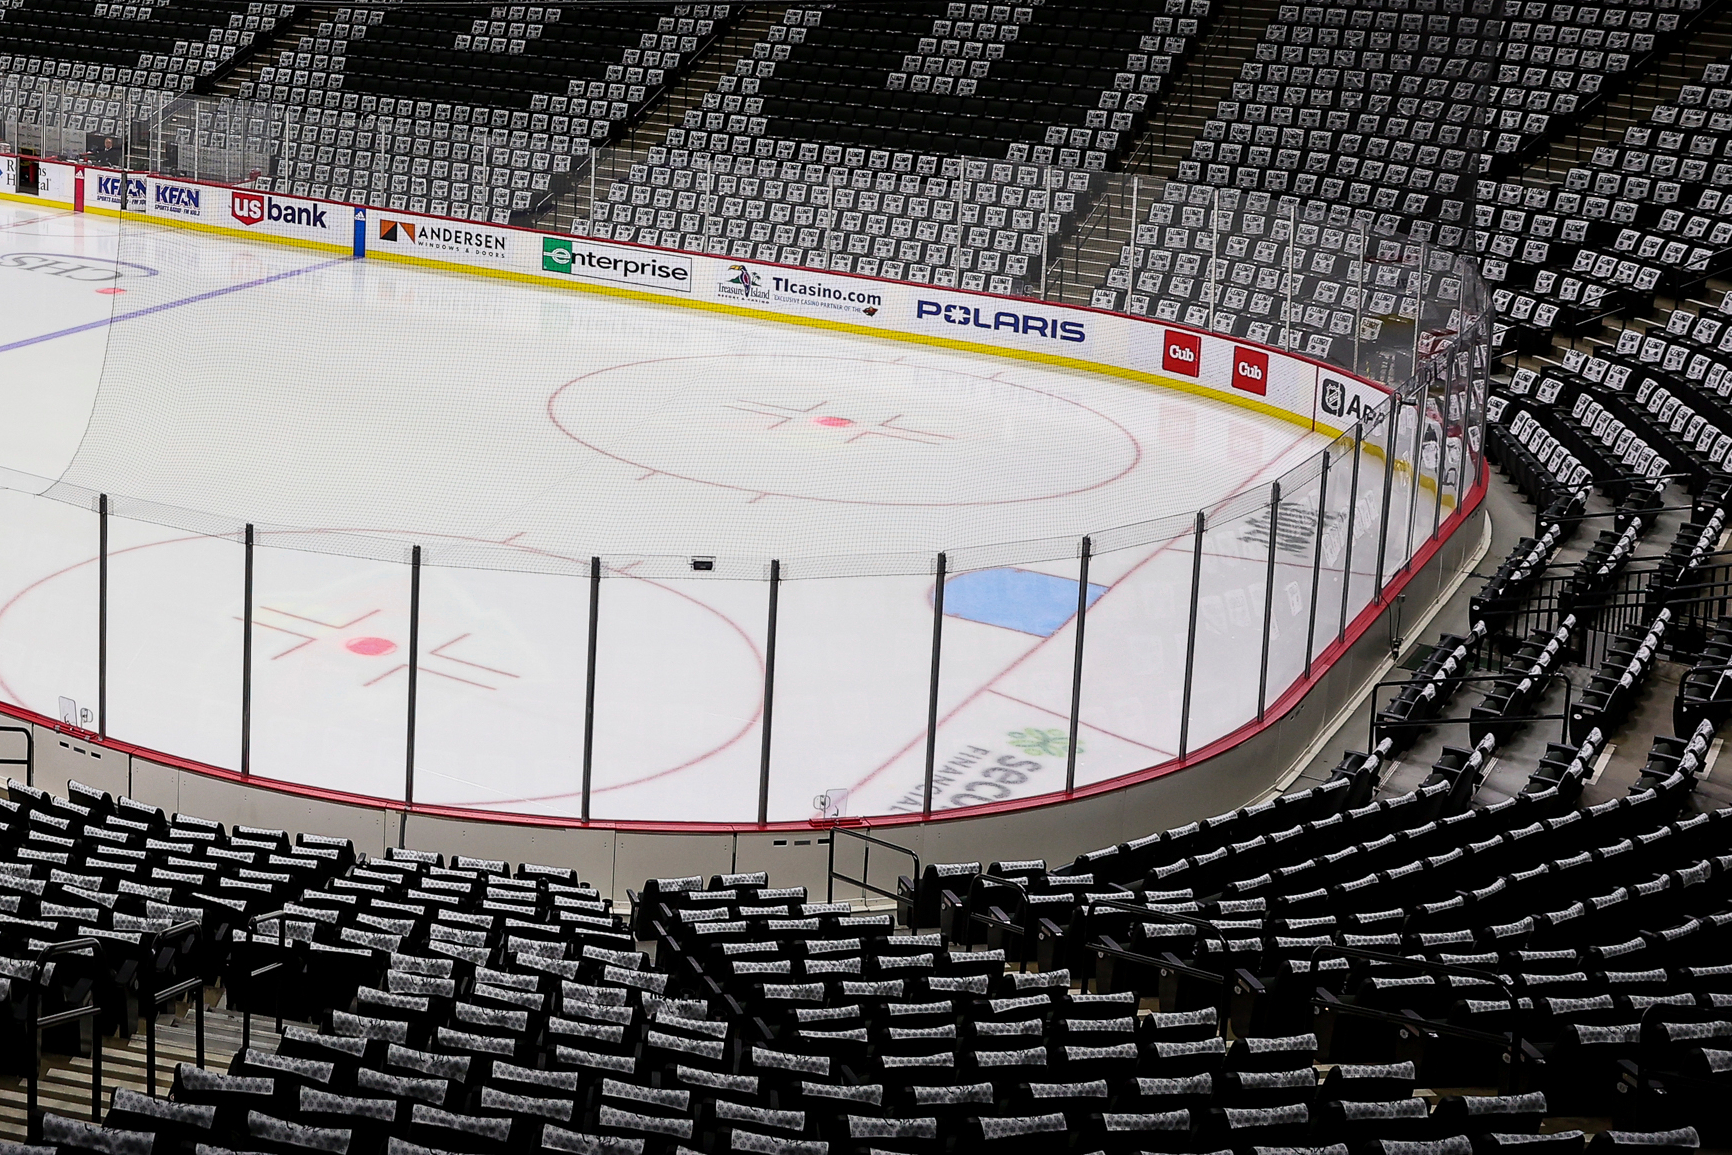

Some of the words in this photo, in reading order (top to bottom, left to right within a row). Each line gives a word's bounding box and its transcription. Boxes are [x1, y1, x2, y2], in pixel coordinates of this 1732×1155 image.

[154, 182, 201, 210] KFAN
[234, 198, 262, 220] us
[268, 193, 328, 229] bank
[417, 241, 460, 253] WINDOWS
[475, 249, 506, 259] DOORS
[418, 225, 506, 250] ANDERSEN
[550, 245, 688, 282] enterprise
[717, 282, 745, 296] Treasure
[750, 286, 770, 300] Island
[773, 277, 881, 305] TIcasino.com
[774, 294, 800, 305] EXCLUSIVE
[800, 298, 820, 307] CASINO
[820, 301, 844, 311] PARTNER
[852, 306, 862, 314] THE
[916, 298, 1086, 344] POLARIS
[1169, 344, 1195, 363] Cub
[1238, 360, 1262, 380] Cub
[889, 744, 990, 813] FINANCIAL
